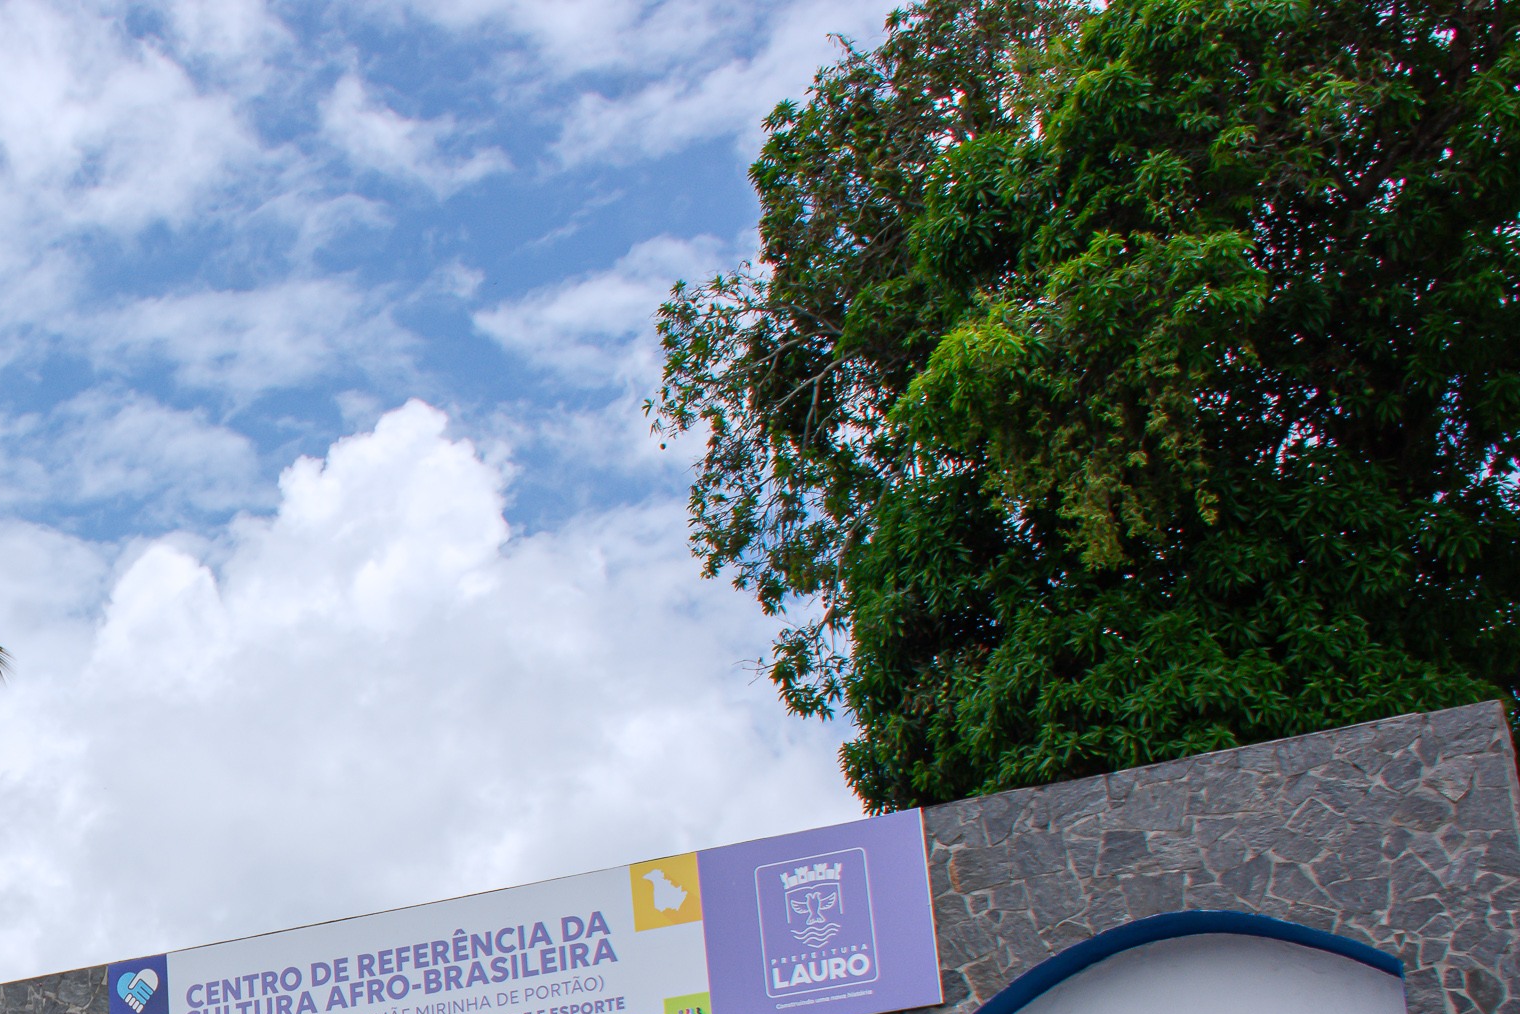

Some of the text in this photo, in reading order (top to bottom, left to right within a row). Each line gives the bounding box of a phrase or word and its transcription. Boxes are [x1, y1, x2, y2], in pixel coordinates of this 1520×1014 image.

[186, 910, 611, 1008] CENTRO DE REFERÊNCIA DA
[771, 943, 868, 966] PREFEITURA
[772, 953, 870, 989] LAURO
[325, 938, 618, 1012] AFRO-BRASILEIRA
[496, 990, 519, 1007] DE
[524, 975, 605, 1002] PORTÃO)
[776, 999, 815, 1010] Construindo
[815, 996, 830, 1004] uma
[847, 989, 873, 998] história
